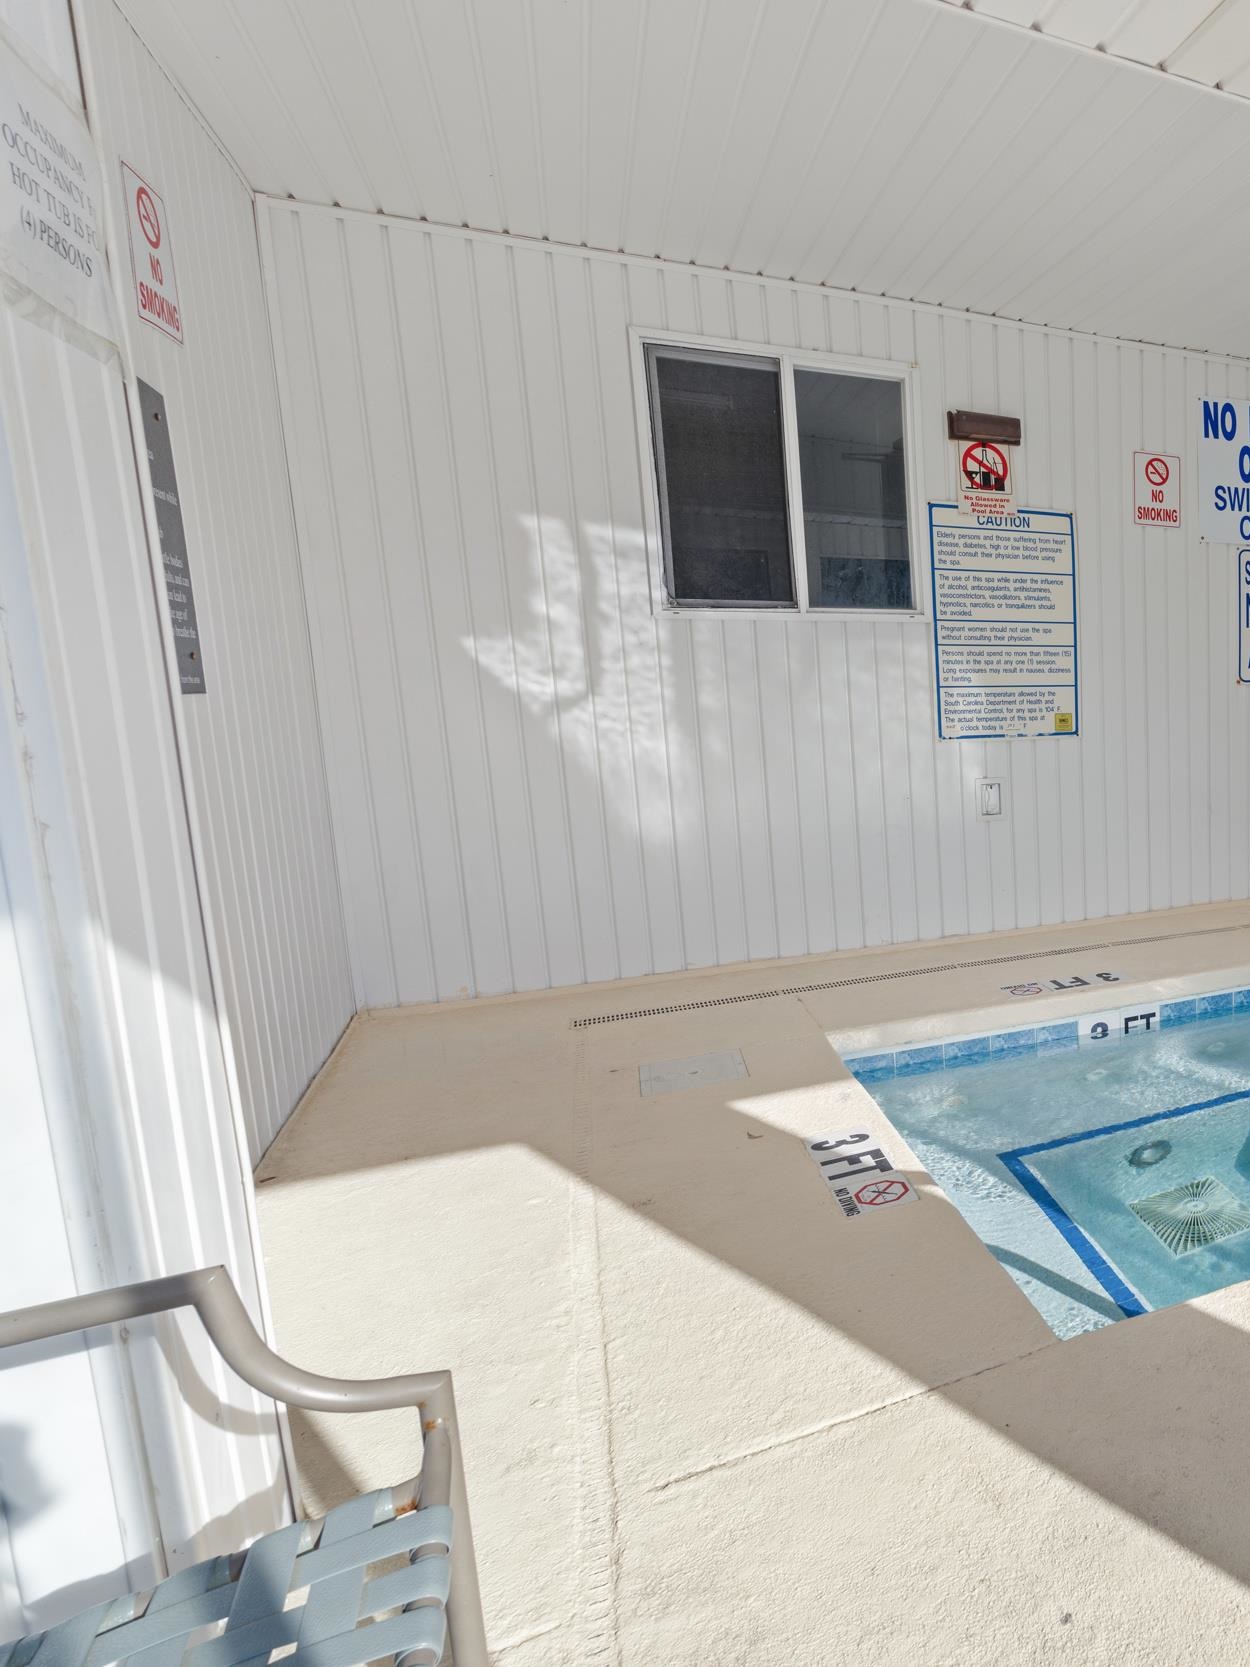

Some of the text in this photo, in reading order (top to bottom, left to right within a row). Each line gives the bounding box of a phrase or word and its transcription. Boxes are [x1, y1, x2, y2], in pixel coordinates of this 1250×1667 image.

[17, 102, 86, 182] MAXIMUM
[2, 123, 85, 208] OCCUPANCY
[9, 161, 40, 203] HOT
[43, 188, 71, 226] TUB
[73, 213, 84, 239] IS
[20, 205, 37, 239] (4)
[39, 219, 93, 277] PERSONS
[149, 251, 163, 286] NO
[139, 281, 180, 332] SMOKING
[1203, 401, 1237, 441] NO
[1151, 489, 1164, 503] NO
[1137, 506, 1178, 522] SMOKING
[977, 515, 1030, 529] CAUTION
[936, 531, 956, 540] Elderly
[958, 534, 981, 542] persons
[1013, 536, 1037, 545] suffering
[990, 543, 1001, 552] high
[957, 550, 979, 558] consult
[995, 553, 1020, 561] physician
[1041, 555, 1055, 563] using
[940, 626, 965, 634] Pregnant
[964, 635, 992, 643] consulting
[984, 691, 1016, 699] temperature
[986, 699, 1017, 707] Department
[976, 716, 1008, 724] temperature
[981, 724, 997, 732] today
[1049, 976, 1090, 990] FT
[1095, 972, 1119, 982] 3
[1091, 1012, 1156, 1040] 3 FT
[810, 1133, 894, 1181] 3 FT
[834, 1187, 861, 1217] NO DIVING
